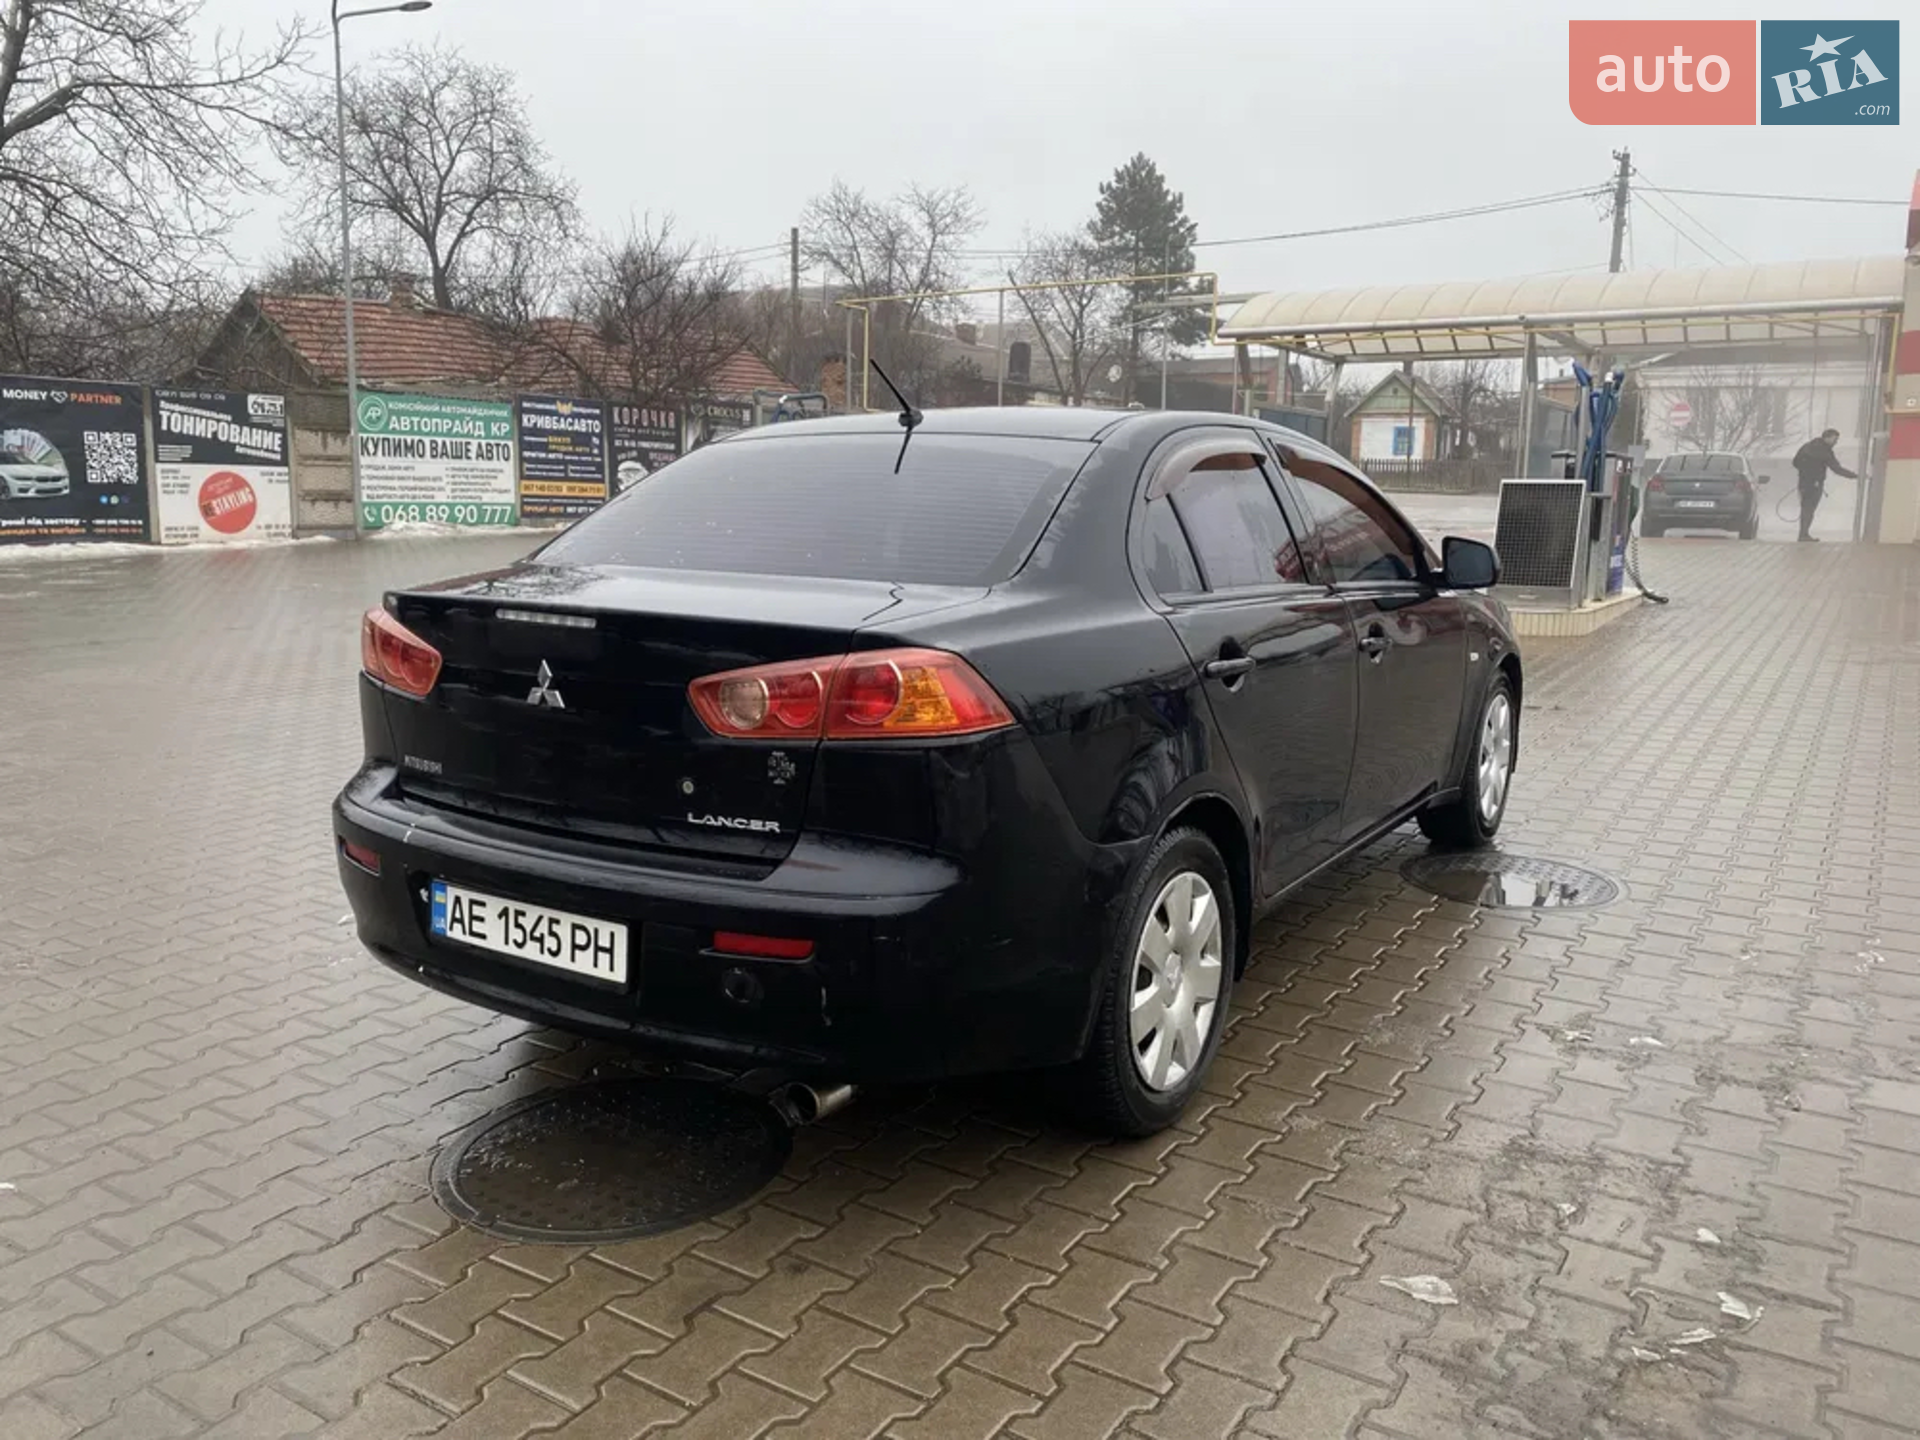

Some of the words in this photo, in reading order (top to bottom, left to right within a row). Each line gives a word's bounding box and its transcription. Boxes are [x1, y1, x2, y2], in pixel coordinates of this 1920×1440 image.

[2, 389, 48, 401] MONEY
[70, 393, 122, 405] PARTNER
[388, 416, 485, 437] АВТОПРАЙД
[490, 422, 510, 437] КР
[522, 414, 602, 433] КРИВБАСАВТО
[612, 406, 676, 430] КОРОЧКА
[159, 410, 283, 452] ТОНИРОВАНИЕ
[360, 436, 426, 458] КУПИМО
[430, 440, 472, 460] ВАШЕ
[475, 442, 511, 461] АВТО
[381, 504, 421, 523] 068
[425, 505, 450, 522] 89
[454, 505, 478, 523] 90
[481, 505, 512, 522] 777
[687, 812, 780, 834] LANCER
[449, 895, 487, 940] AE
[497, 906, 562, 958] 1545
[570, 921, 615, 972] PH
